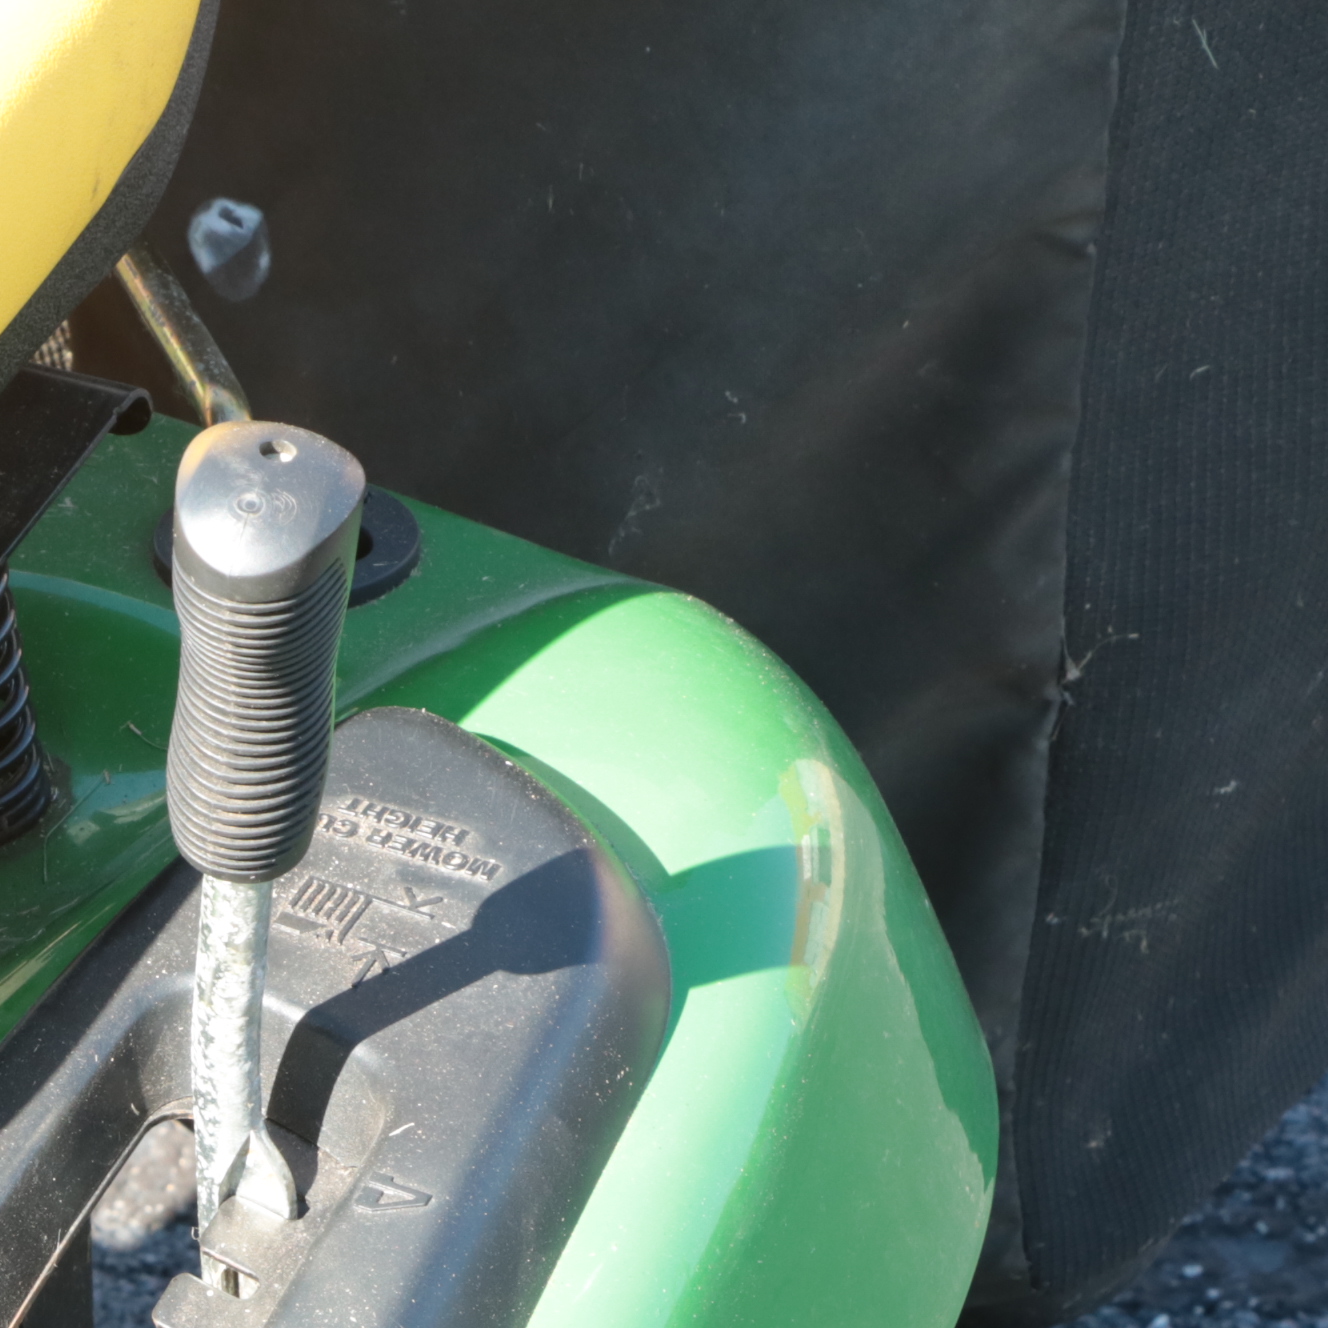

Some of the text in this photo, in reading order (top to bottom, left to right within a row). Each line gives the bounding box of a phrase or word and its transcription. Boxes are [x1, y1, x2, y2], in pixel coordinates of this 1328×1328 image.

[315, 812, 503, 882] MOWER CU
[336, 797, 471, 848] HEIGHT
[352, 1170, 434, 1214] 4
